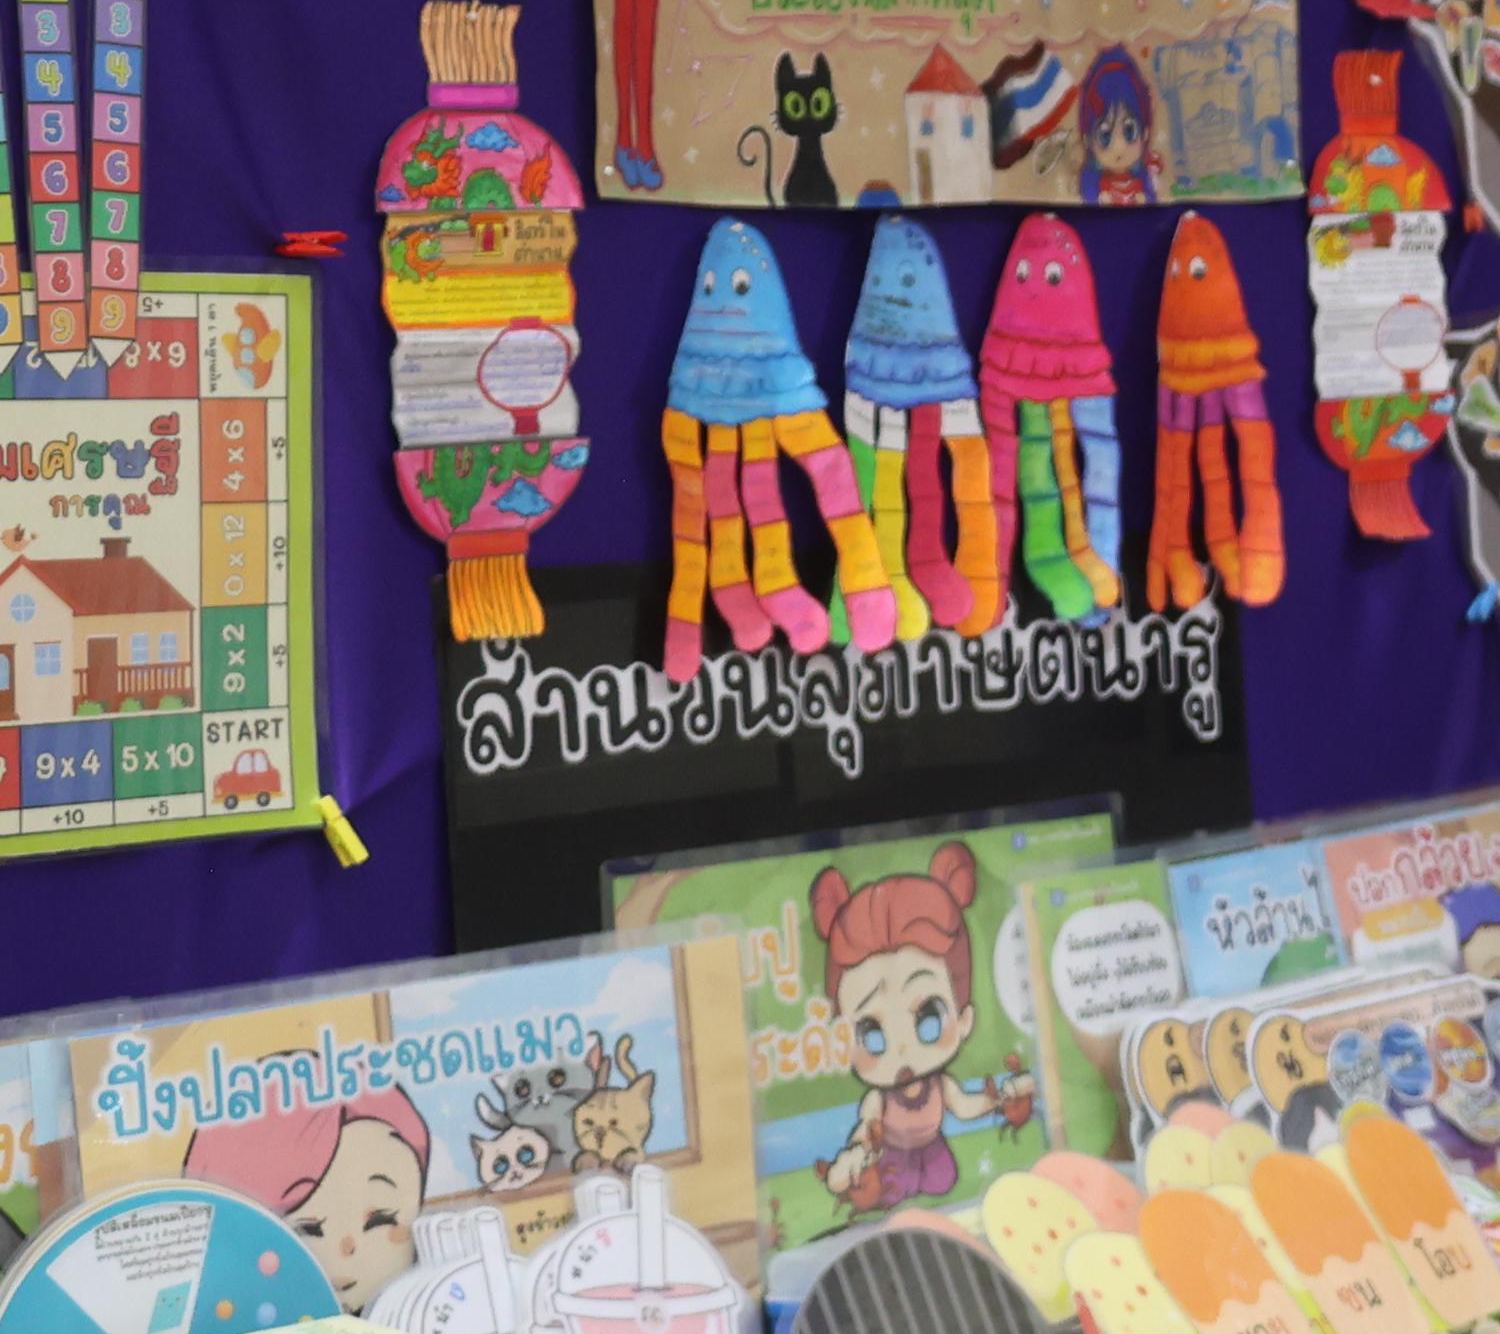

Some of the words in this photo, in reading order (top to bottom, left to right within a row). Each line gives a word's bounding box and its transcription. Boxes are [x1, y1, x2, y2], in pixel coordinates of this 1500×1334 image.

[36, 10, 58, 43] 3
[110, 2, 131, 37] 3
[36, 60, 62, 95] 4
[106, 50, 131, 87] 4
[43, 112, 63, 143] 5
[107, 102, 129, 133] 5
[44, 161, 68, 195] 6
[105, 150, 129, 184] 6
[46, 210, 68, 243] 7
[105, 198, 127, 232] 7
[50, 259, 72, 294] 8
[105, 246, 126, 281] 8
[50, 493, 151, 530] การคูณ
[205, 717, 285, 744] START
[52, 807, 85, 827] +10
[146, 799, 170, 818] +5
[97, 1012, 587, 1139] ปิ้งปลาประชดแมว
